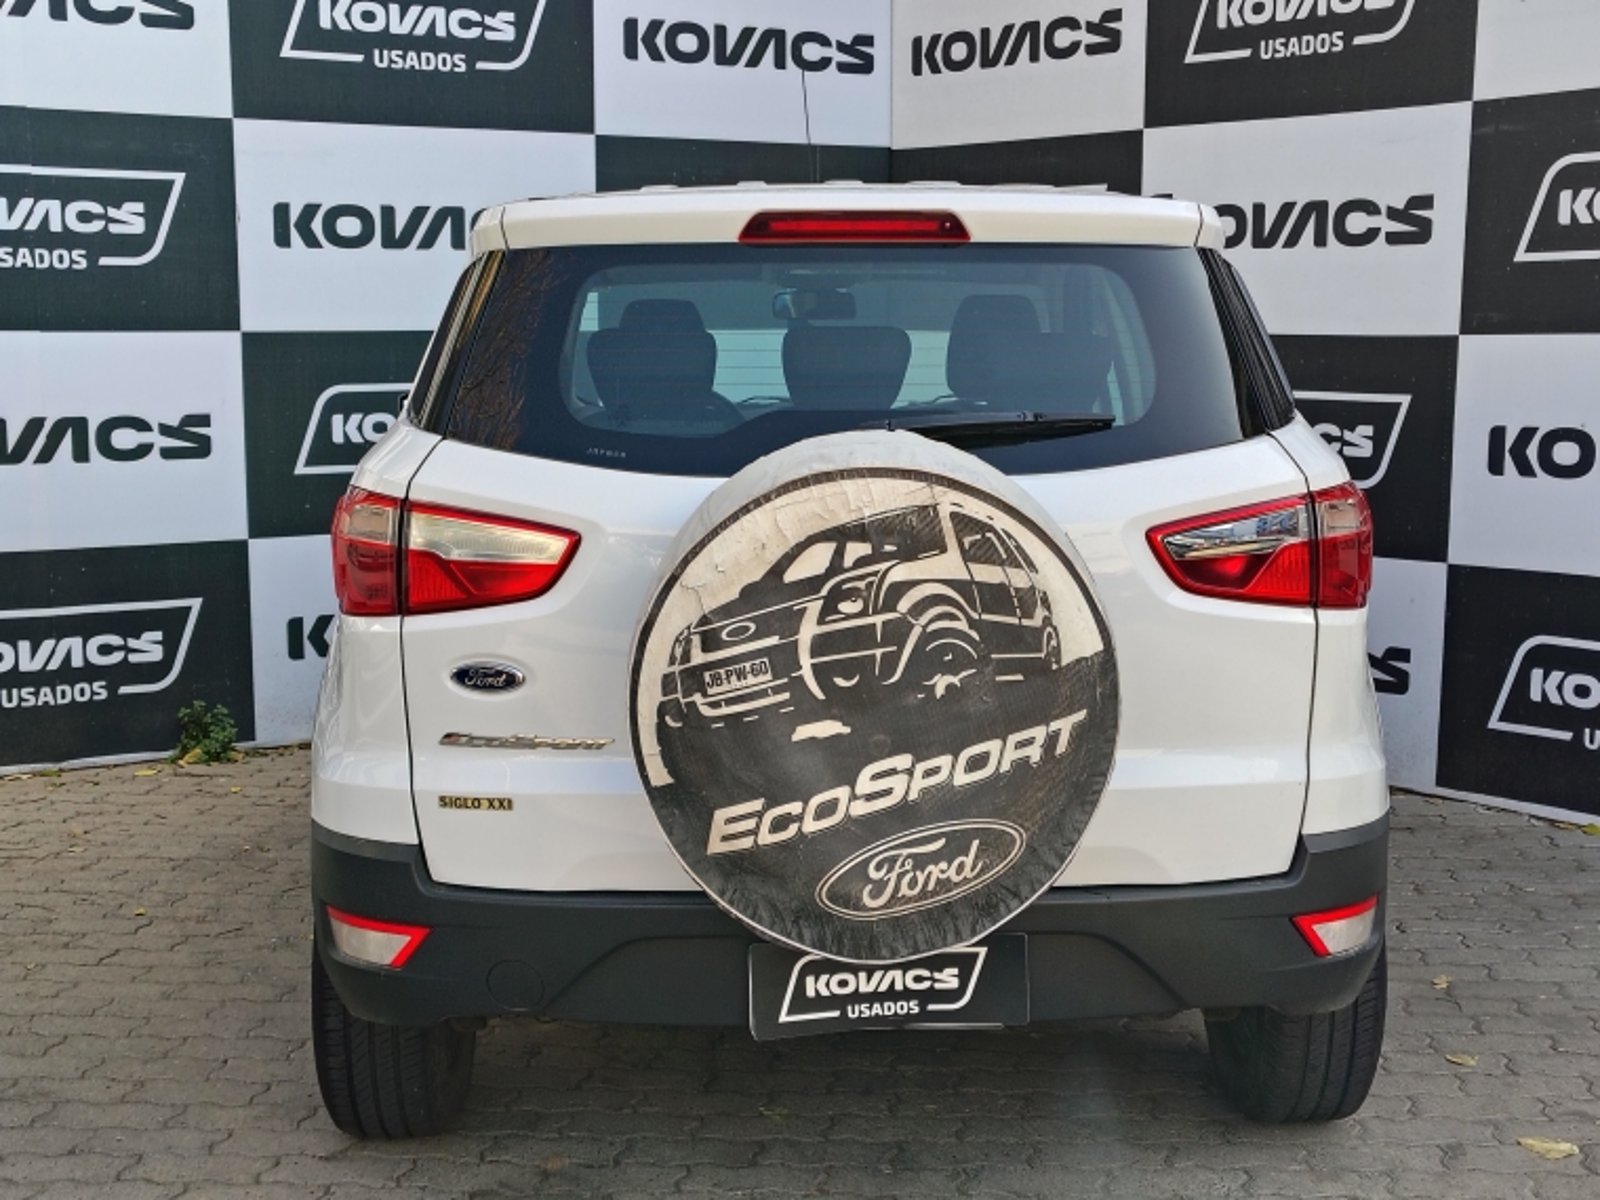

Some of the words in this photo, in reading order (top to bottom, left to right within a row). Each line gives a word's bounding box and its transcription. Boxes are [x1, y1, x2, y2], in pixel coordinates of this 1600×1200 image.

[319, 0, 515, 41] KOVACS
[623, 17, 875, 75] KOVACS
[911, 8, 1122, 76] KOVACS
[1260, 31, 1344, 59] USADOS
[373, 48, 467, 72] USADOS
[464, 668, 506, 688] Ford
[1, 681, 108, 709] USADOS
[438, 795, 481, 810] SIGLO
[486, 797, 513, 811] XXI
[862, 836, 983, 910] Ford
[805, 966, 960, 999] KOVACS
[846, 1000, 920, 1020] USADOS
